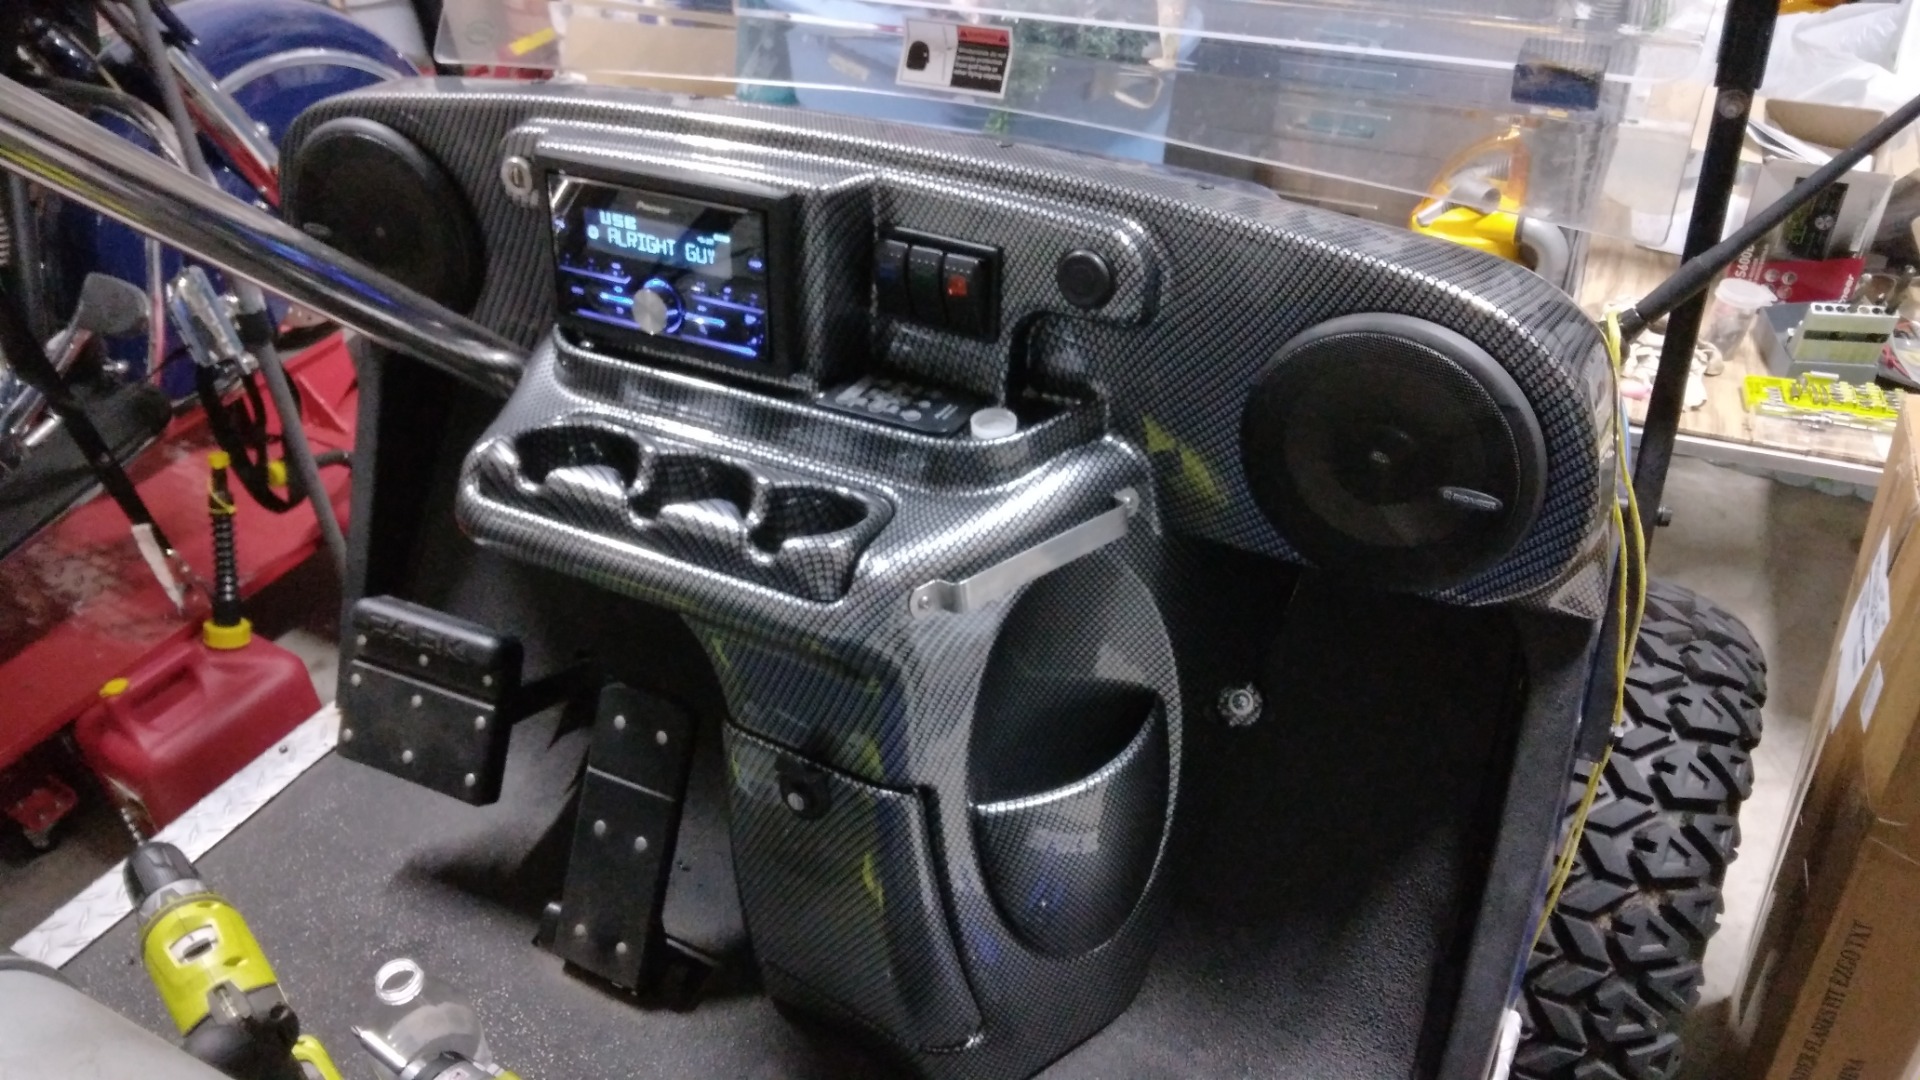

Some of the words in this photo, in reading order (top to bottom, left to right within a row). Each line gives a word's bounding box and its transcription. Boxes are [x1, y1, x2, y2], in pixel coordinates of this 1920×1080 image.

[600, 210, 637, 231] USB
[607, 228, 675, 256] ALRIGHT
[685, 243, 715, 264] GUY
[1845, 919, 1874, 949] TXT
